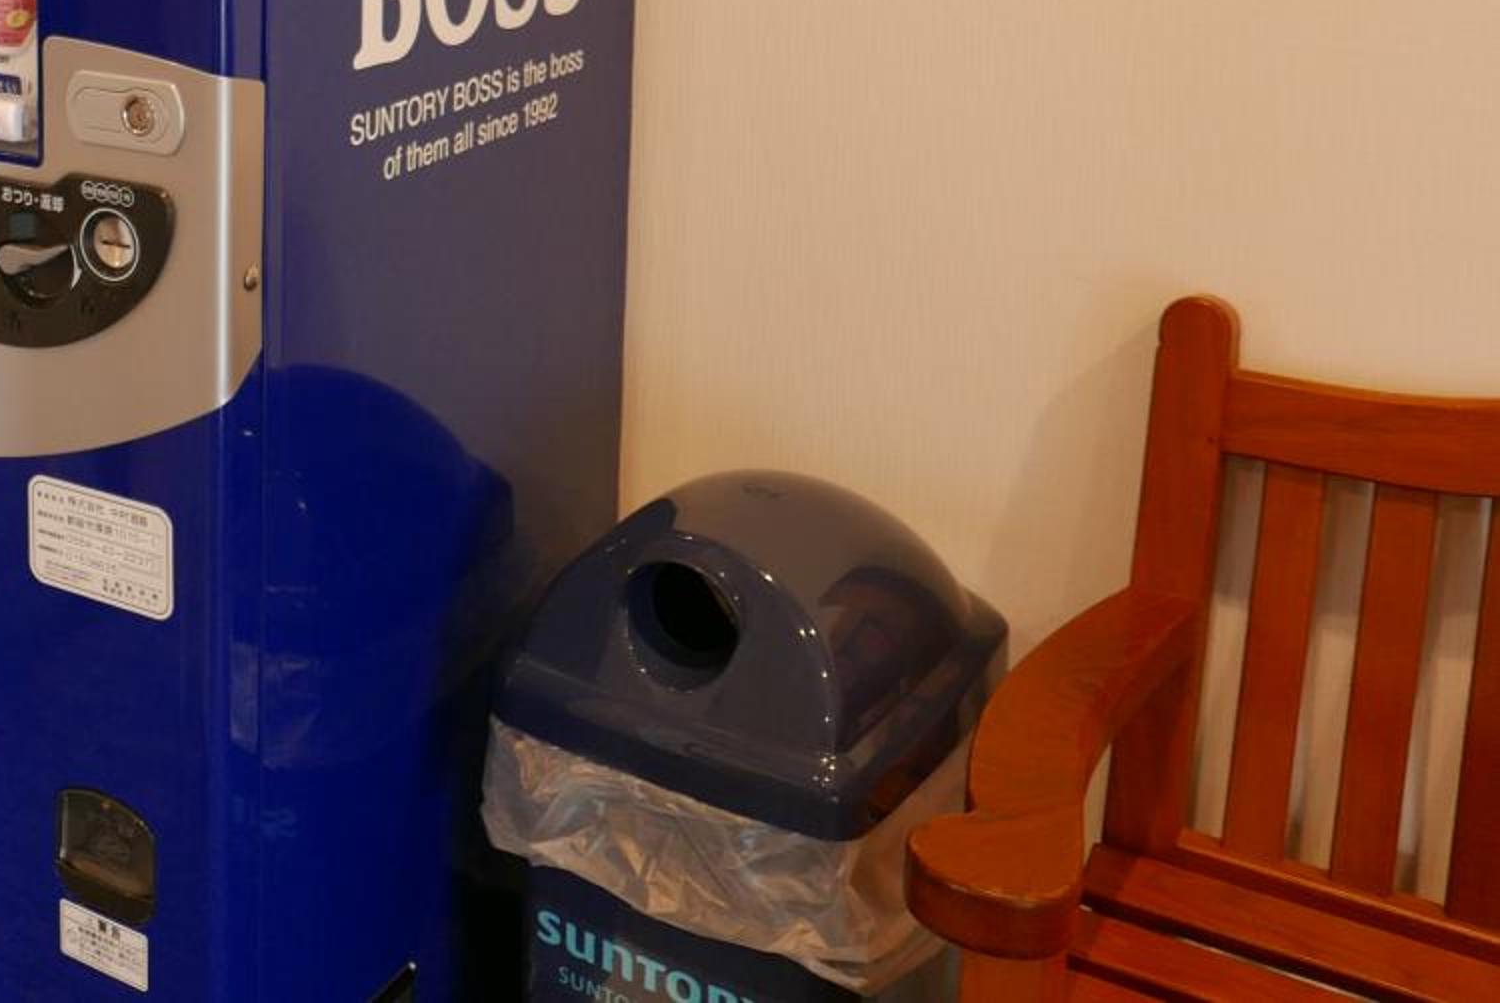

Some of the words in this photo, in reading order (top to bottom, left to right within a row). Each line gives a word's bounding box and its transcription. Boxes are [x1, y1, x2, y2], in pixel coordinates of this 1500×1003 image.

[350, 85, 449, 146] SUNTORY
[454, 69, 503, 111] BOSS
[507, 68, 521, 93] is
[523, 60, 547, 89] the
[550, 49, 584, 80] boss
[383, 144, 402, 181] of
[407, 135, 449, 172] them
[454, 122, 474, 154] all
[478, 110, 518, 146] since
[524, 93, 558, 128] 1992
